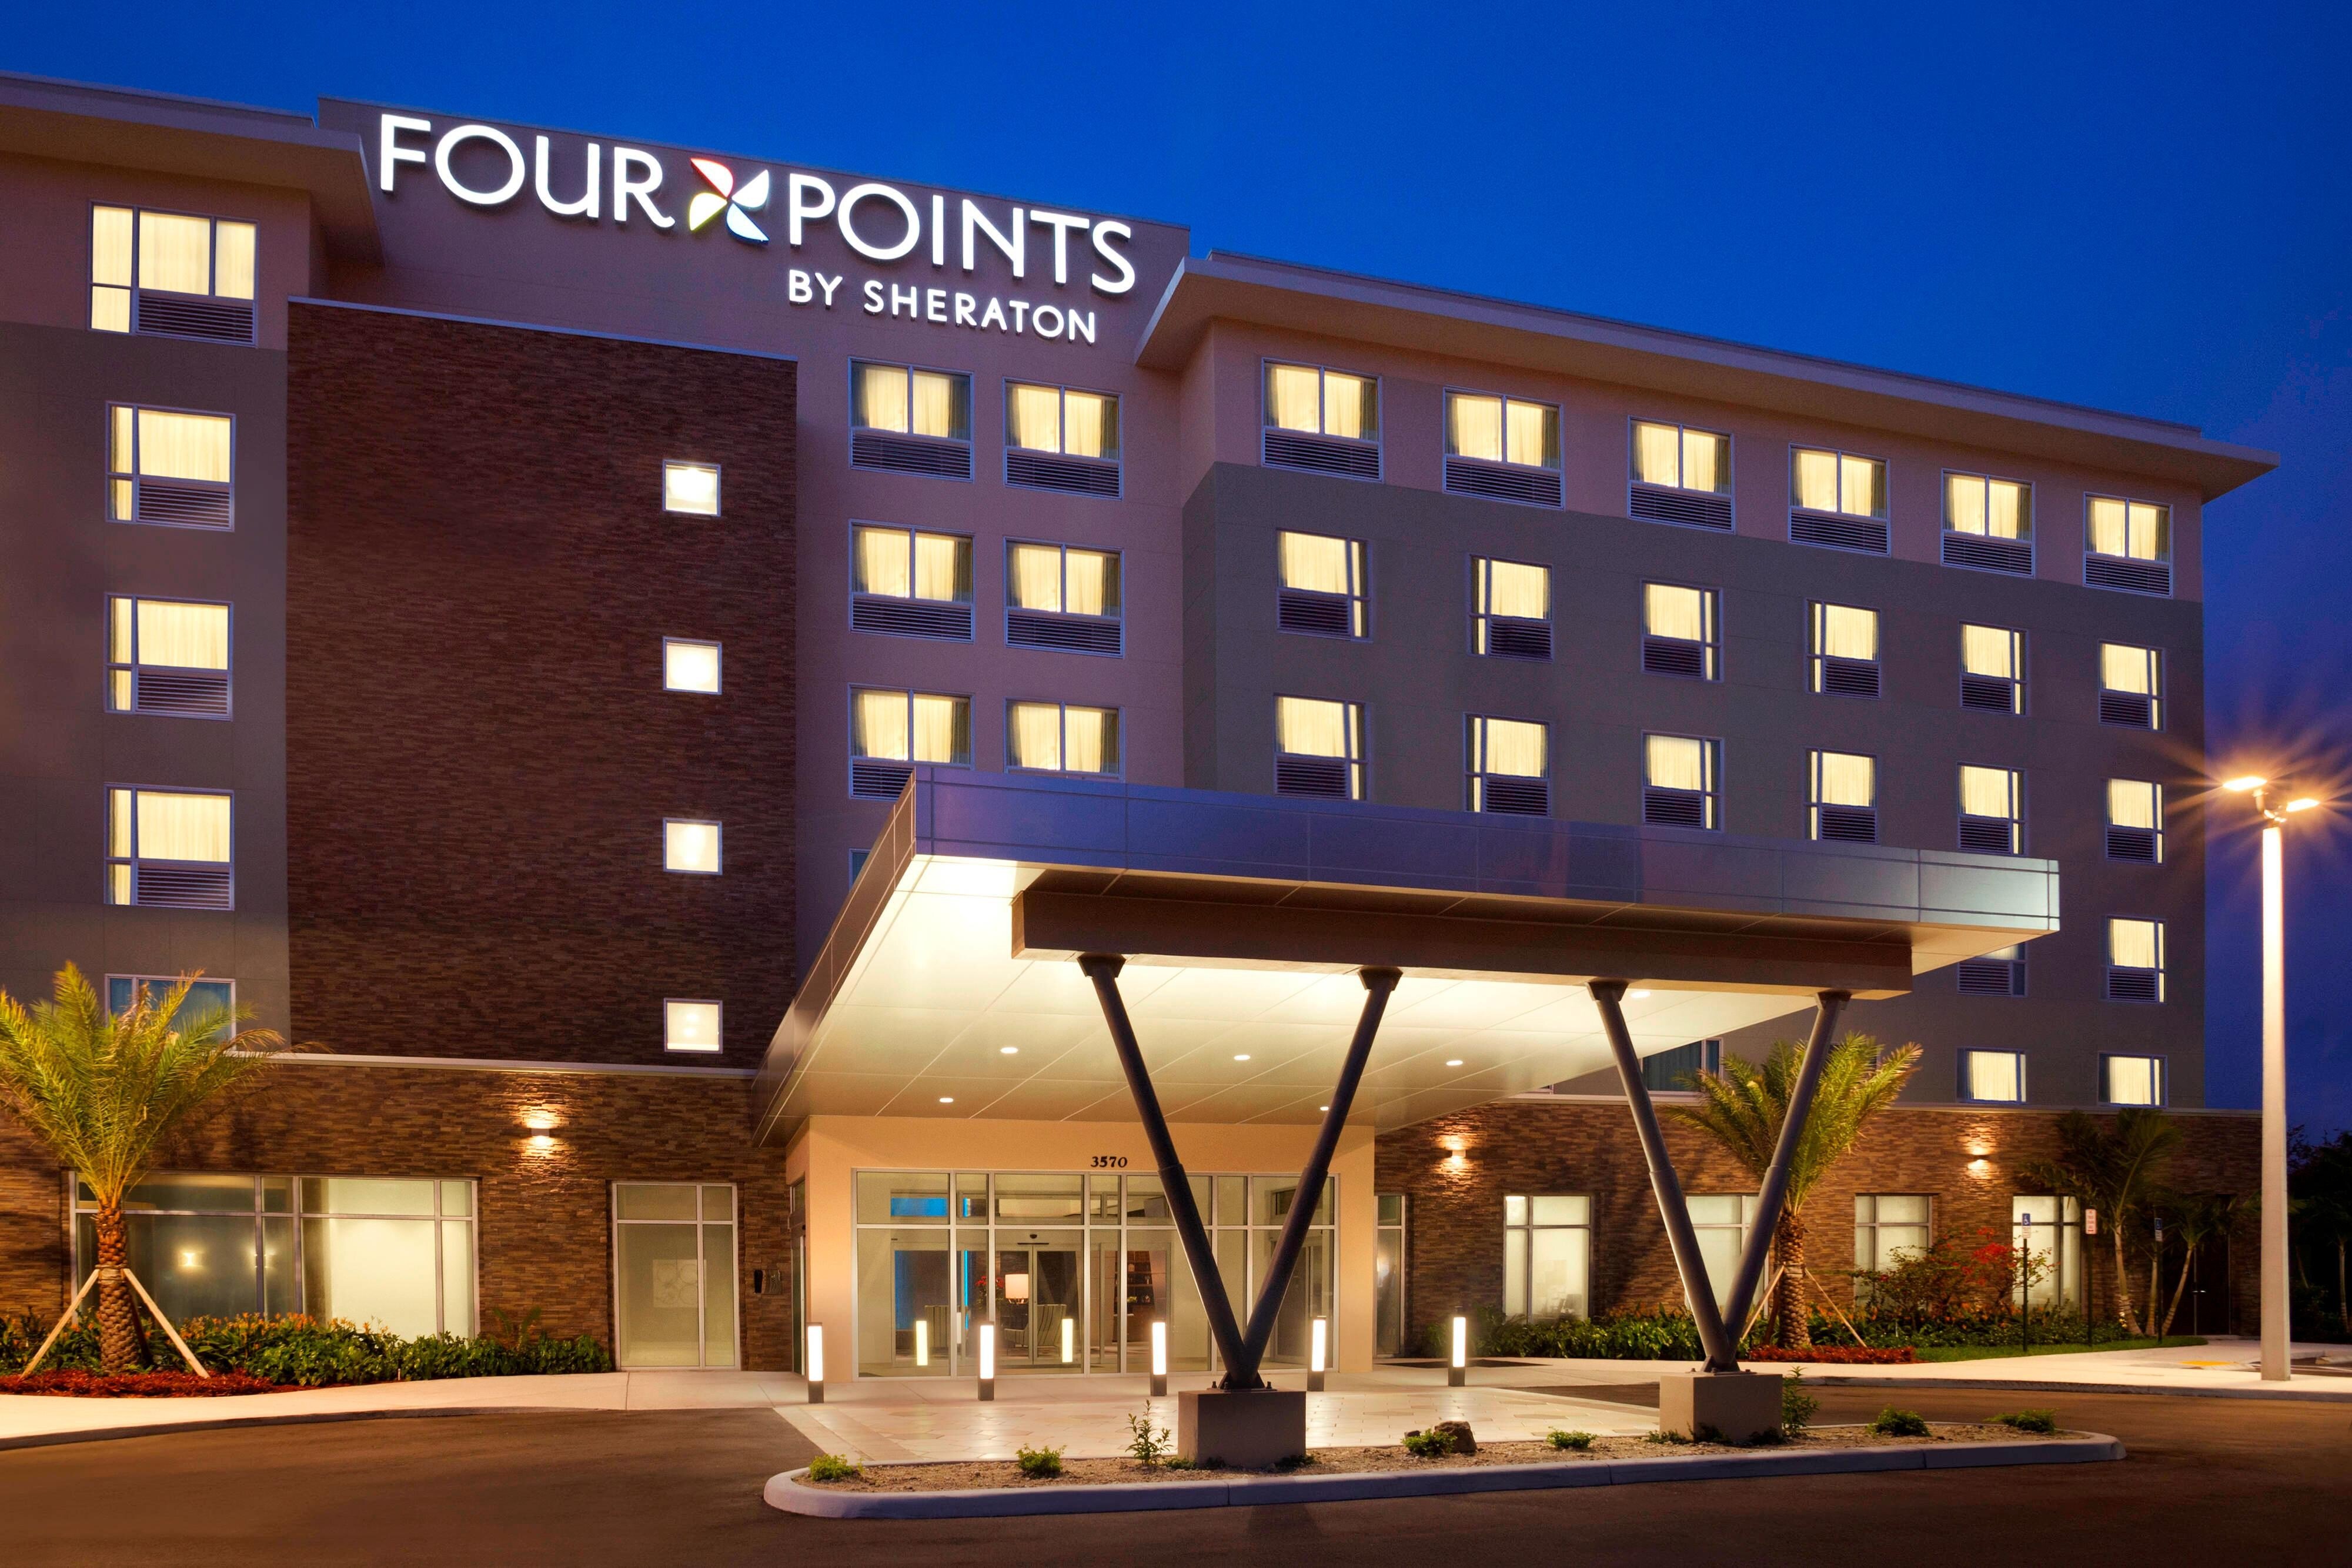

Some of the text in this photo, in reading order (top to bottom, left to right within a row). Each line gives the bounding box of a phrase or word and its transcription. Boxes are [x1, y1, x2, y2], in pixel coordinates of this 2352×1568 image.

[380, 113, 1136, 293] FOUR POINTS
[788, 269, 1096, 344] BY SHERATON
[1090, 1156, 1128, 1168] 3570
